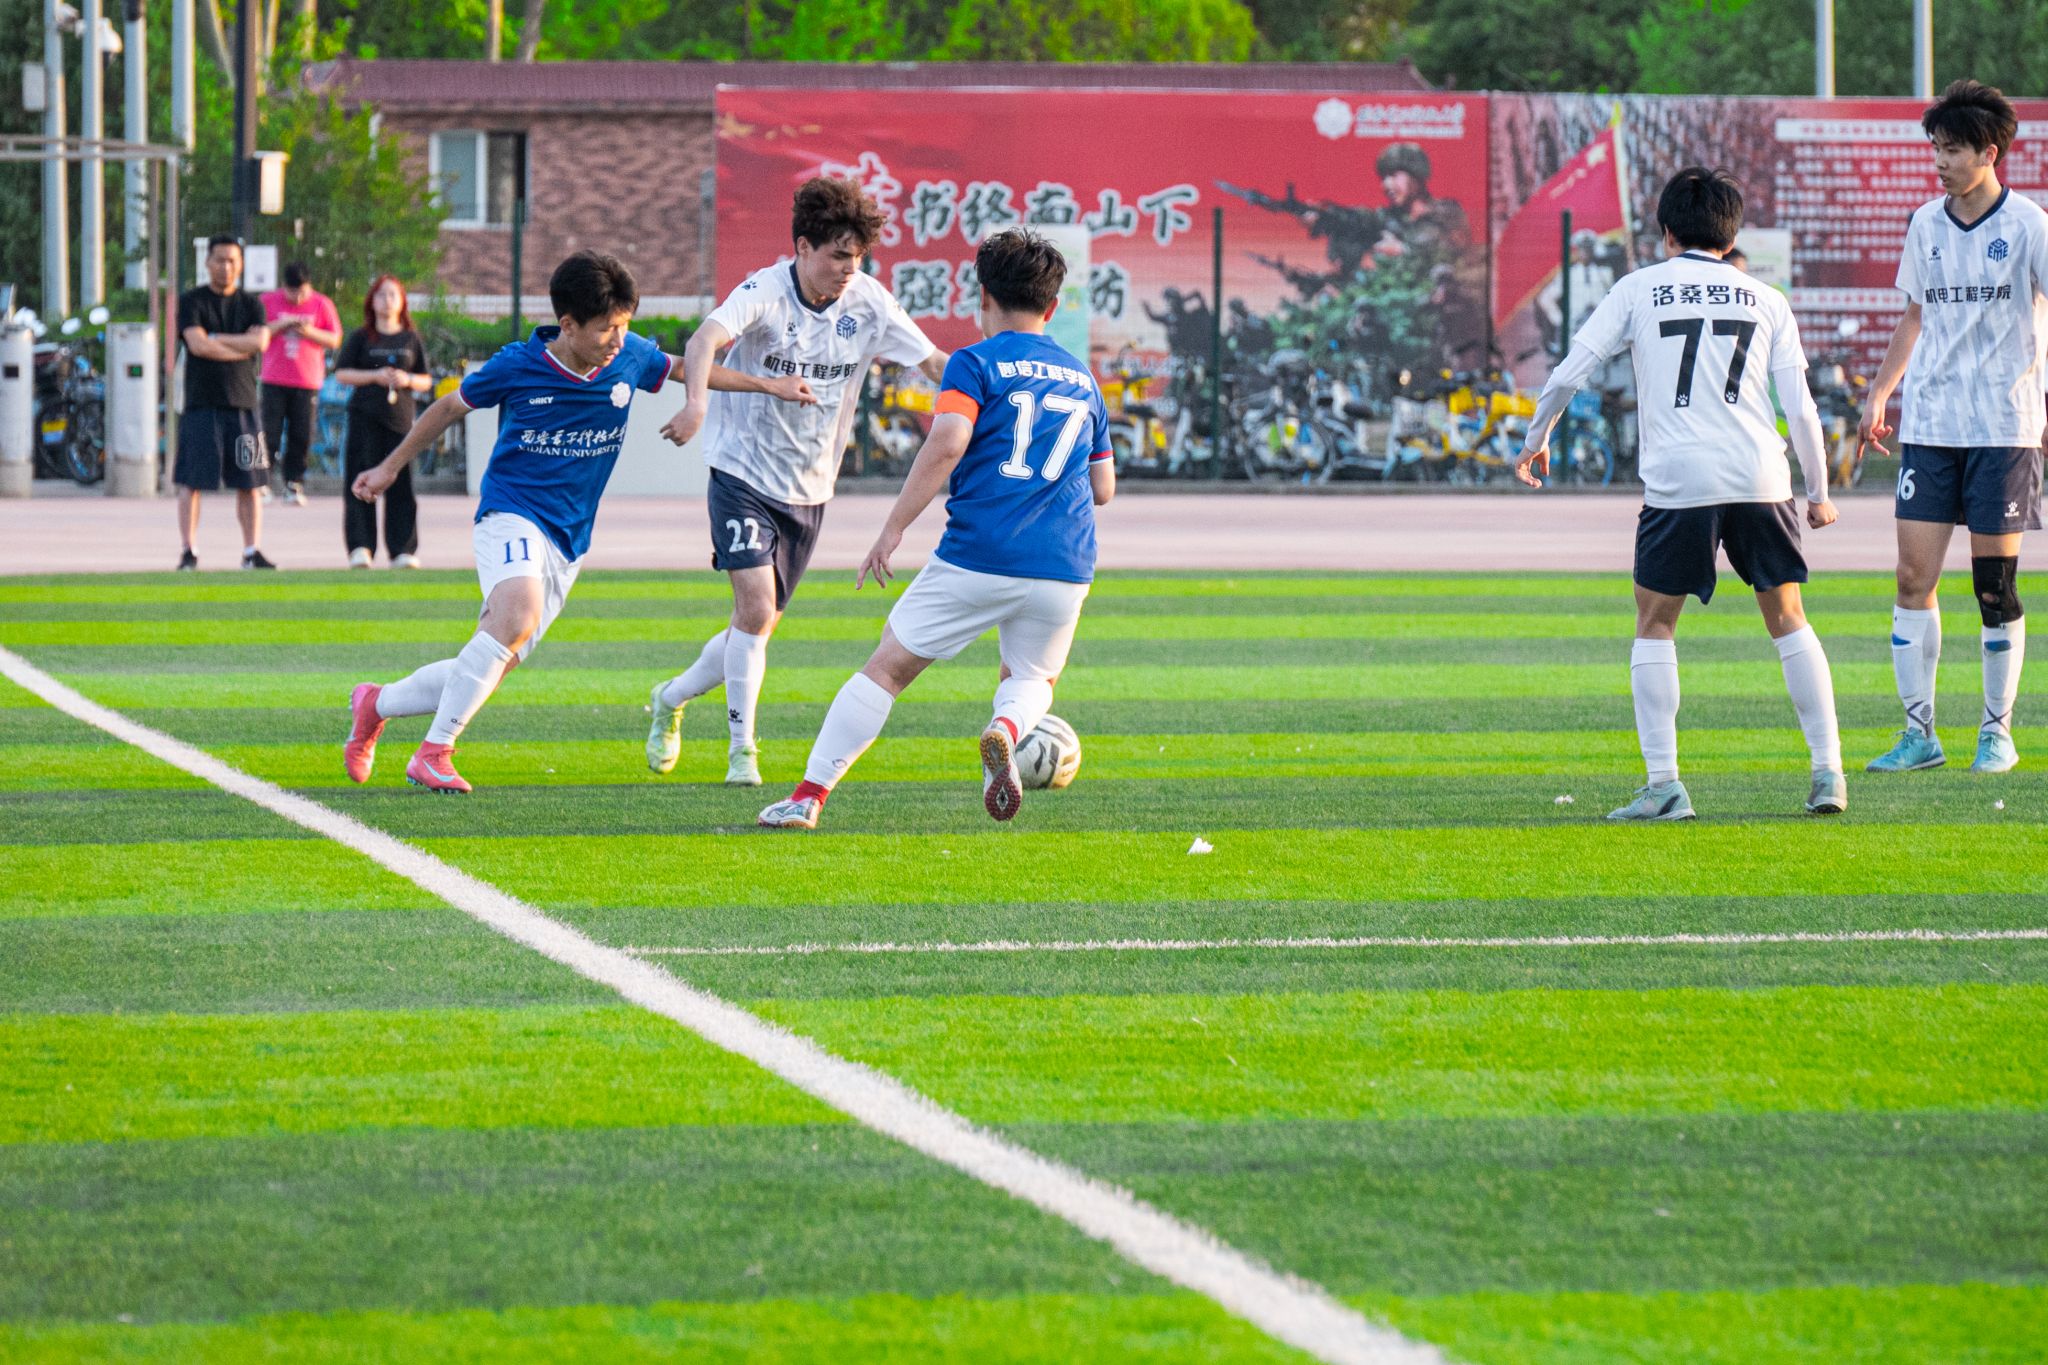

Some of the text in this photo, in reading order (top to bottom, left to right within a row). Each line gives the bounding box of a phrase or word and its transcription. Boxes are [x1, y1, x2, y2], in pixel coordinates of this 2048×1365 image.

[1652, 283, 1757, 308] 洛桑罗布
[1925, 284, 2012, 304] 机电工程学院
[1659, 318, 1758, 409] 77
[998, 391, 1089, 480] 17
[503, 537, 531, 564] 11
[726, 517, 762, 553] 22
